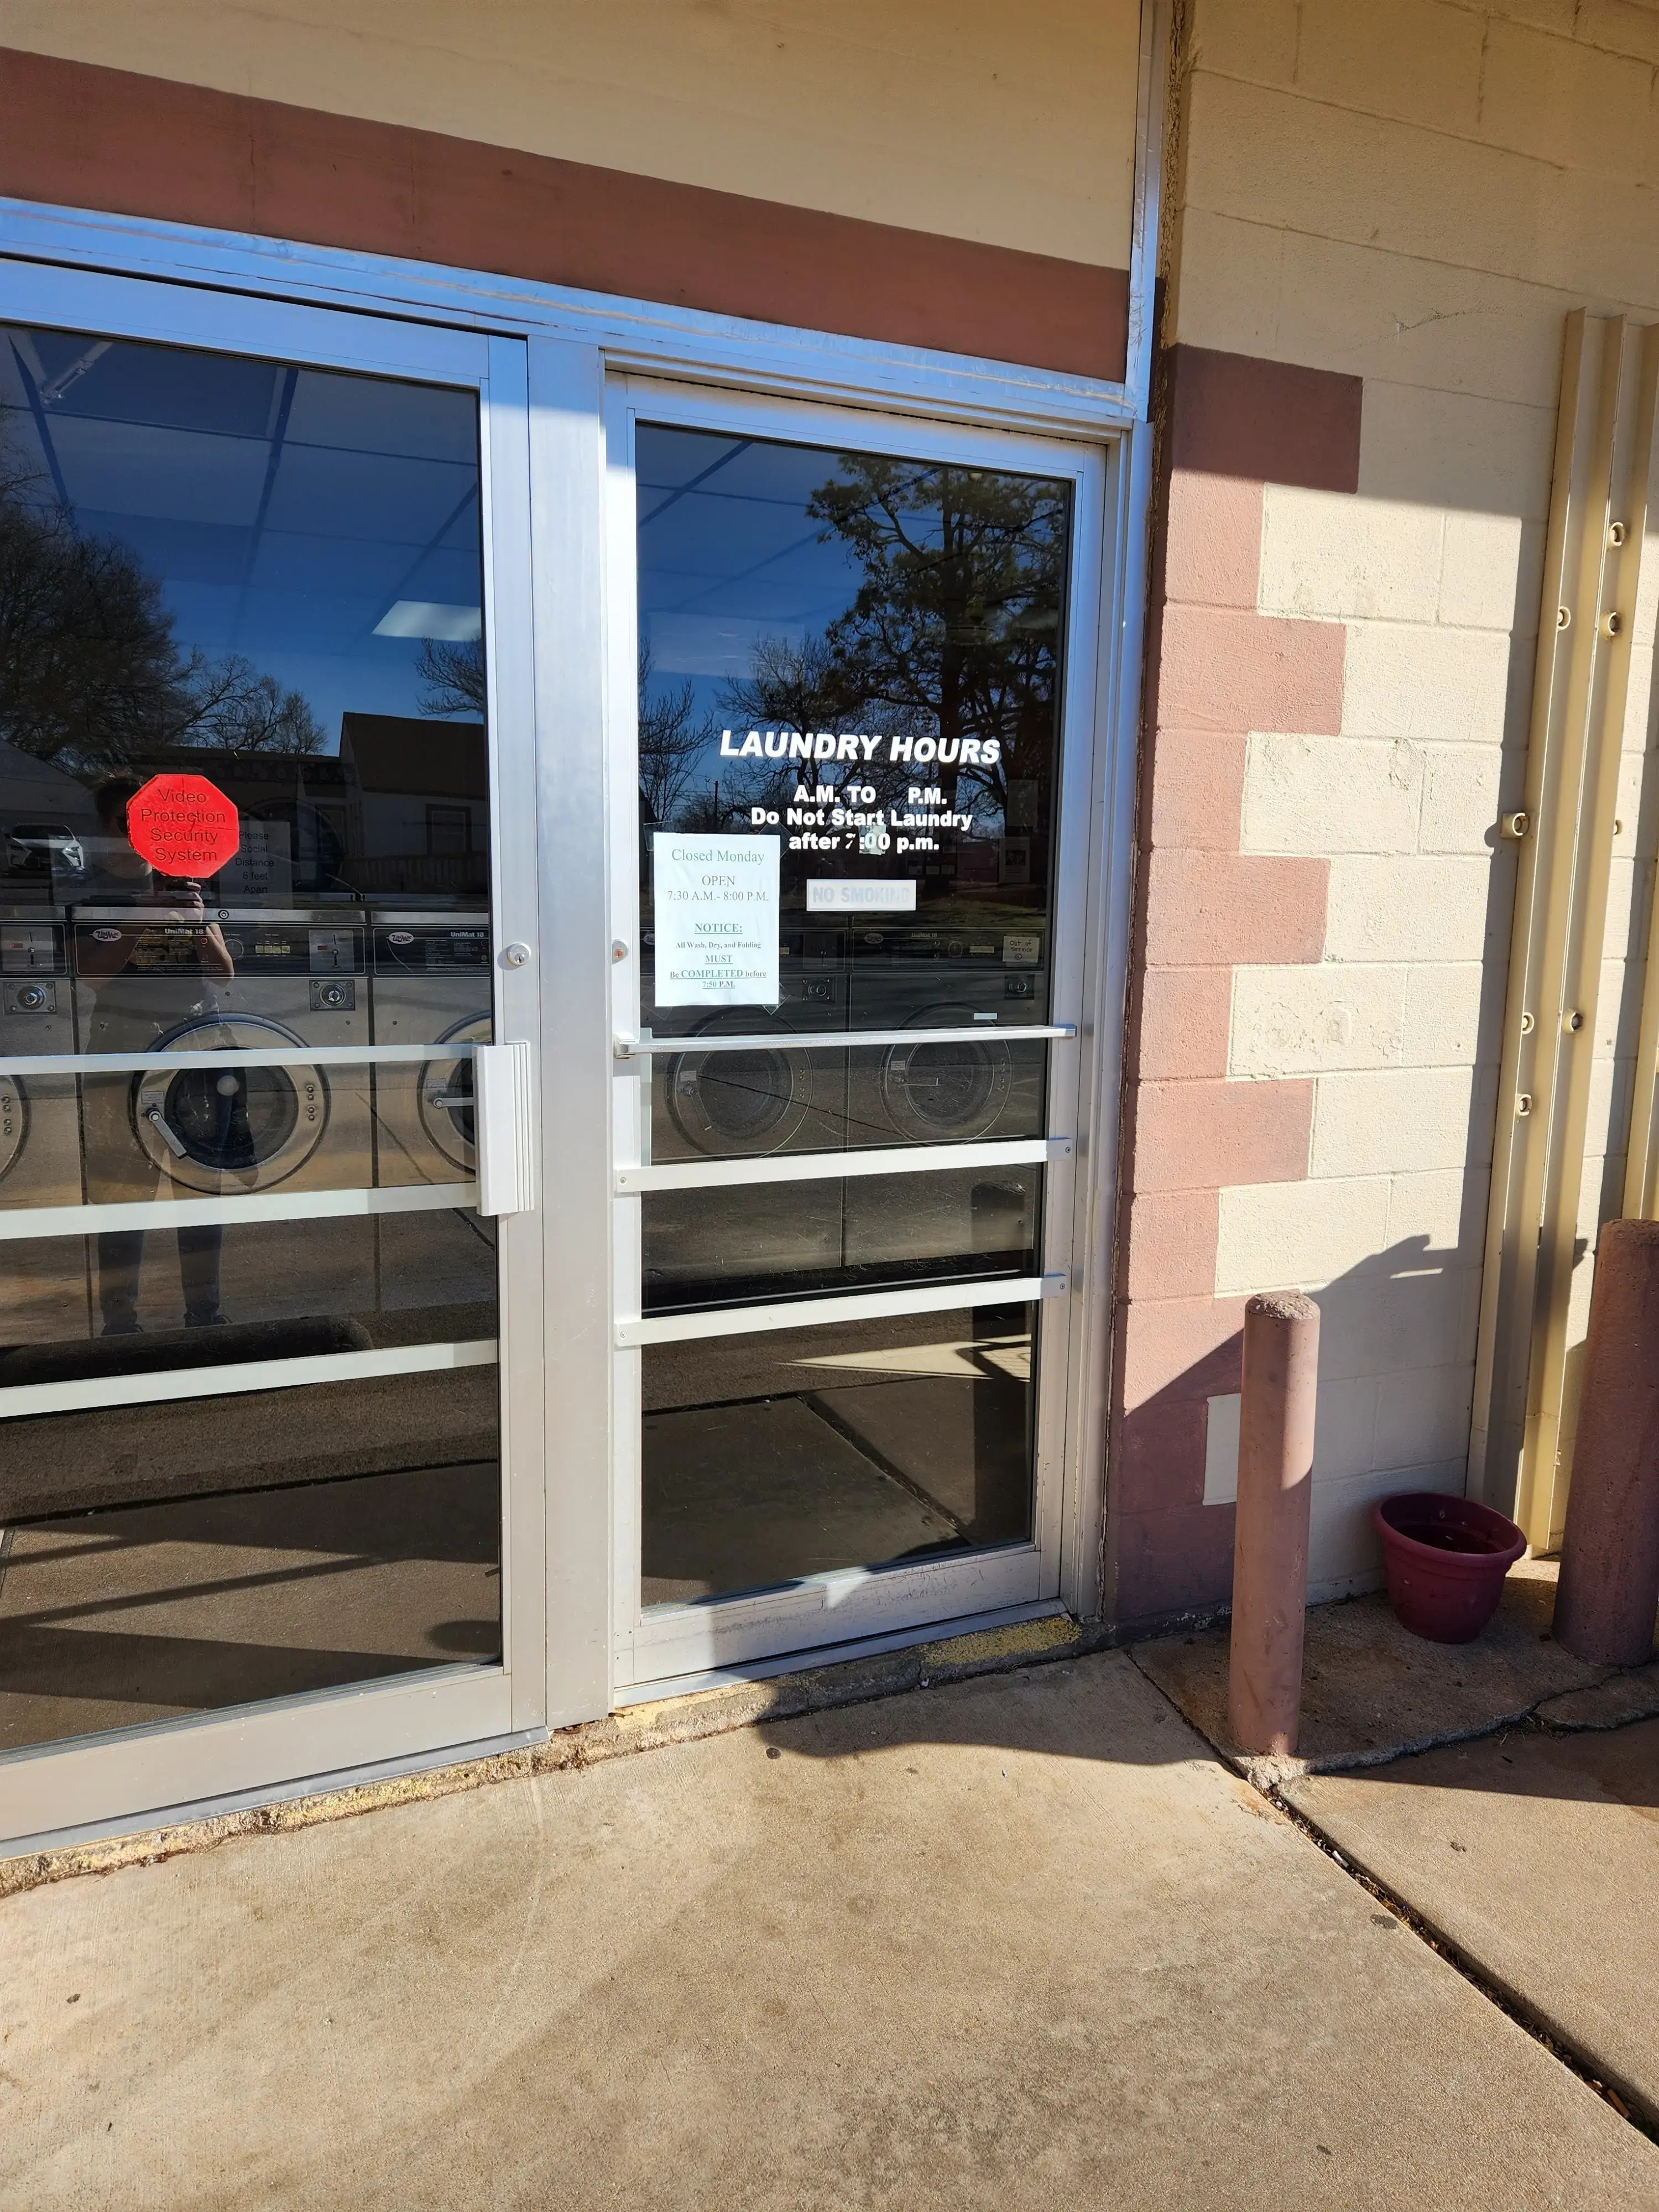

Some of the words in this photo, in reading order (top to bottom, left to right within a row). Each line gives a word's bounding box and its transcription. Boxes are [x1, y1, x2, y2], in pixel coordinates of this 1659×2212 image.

[719, 730, 882, 760] LAUNDRY
[889, 736, 1000, 764] HOURS
[158, 789, 206, 803] Video
[794, 785, 841, 802] A.M.
[847, 785, 877, 804] TO
[908, 787, 947, 805] P.M.
[141, 808, 226, 823] Protection
[751, 807, 780, 825] Do
[787, 808, 825, 825] Not
[831, 808, 884, 826] Start
[891, 810, 973, 831] Laundry
[150, 828, 218, 845] Security
[789, 833, 841, 849] after
[896, 837, 940, 854] p.m.
[155, 848, 217, 864] System
[241, 845, 268, 853] Social
[235, 858, 274, 867] Distance
[671, 848, 713, 862] Closed
[717, 850, 765, 865] Monday
[251, 872, 268, 880] feet
[702, 875, 735, 886] OPEN
[244, 885, 268, 894] Apart
[667, 891, 688, 900] 7:30
[723, 891, 744, 900] 8:00
[747, 891, 769, 901] P.M.
[813, 887, 834, 902] NO
[695, 924, 743, 934] NOTICE:
[705, 955, 733, 964] MUST
[681, 970, 743, 978] COMPLETED
